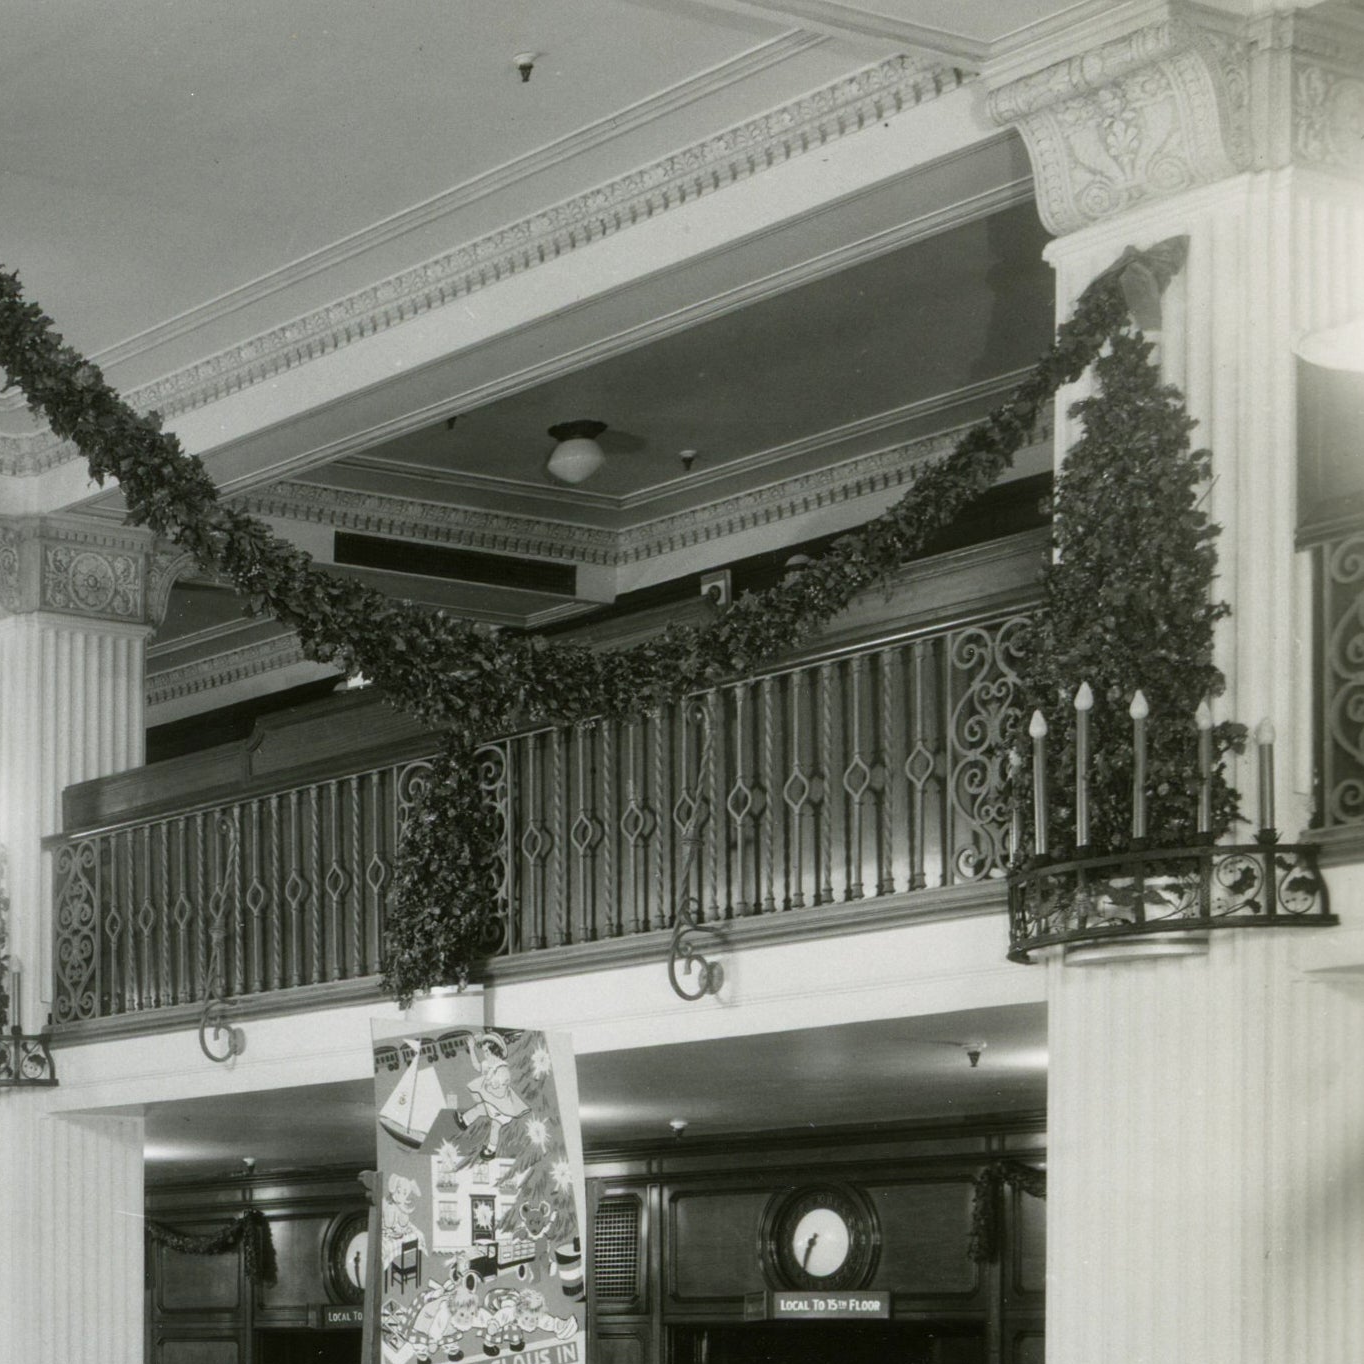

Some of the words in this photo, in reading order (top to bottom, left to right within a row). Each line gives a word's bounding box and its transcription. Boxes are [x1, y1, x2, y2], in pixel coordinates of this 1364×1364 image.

[780, 1299, 811, 1311] LOCAL
[849, 1299, 881, 1311] FLOOR
[328, 1312, 351, 1322] LOCAL
[353, 1311, 363, 1321] TO
[557, 1343, 576, 1364] IN
